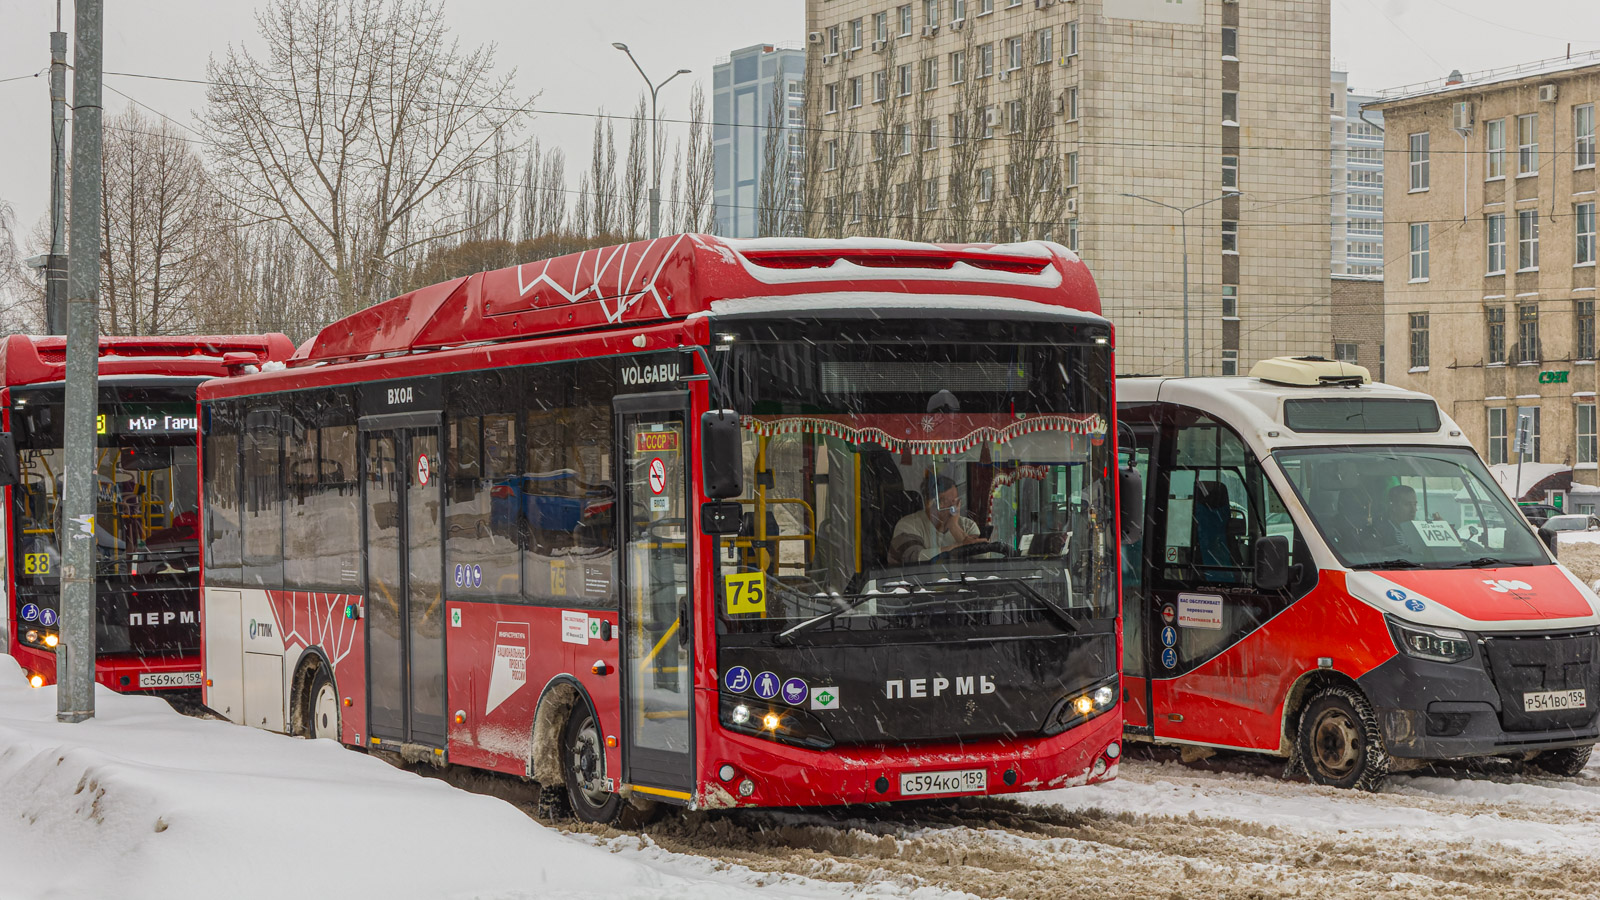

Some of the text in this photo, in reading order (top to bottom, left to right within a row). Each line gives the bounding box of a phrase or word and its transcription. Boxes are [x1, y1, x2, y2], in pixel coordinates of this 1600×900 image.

[387, 386, 413, 405] ВХОД
[646, 434, 667, 449] СССР
[1423, 529, 1456, 541] ИВА
[27, 554, 49, 572] 38
[551, 567, 565, 588] 75
[728, 579, 763, 606] 75
[129, 610, 201, 626] ПЕРМ
[257, 623, 273, 638] ГТЛК
[184, 673, 200, 682] 159
[886, 675, 996, 699] ПЕРМЬ
[1568, 691, 1582, 702] 159
[962, 771, 983, 785] 159
